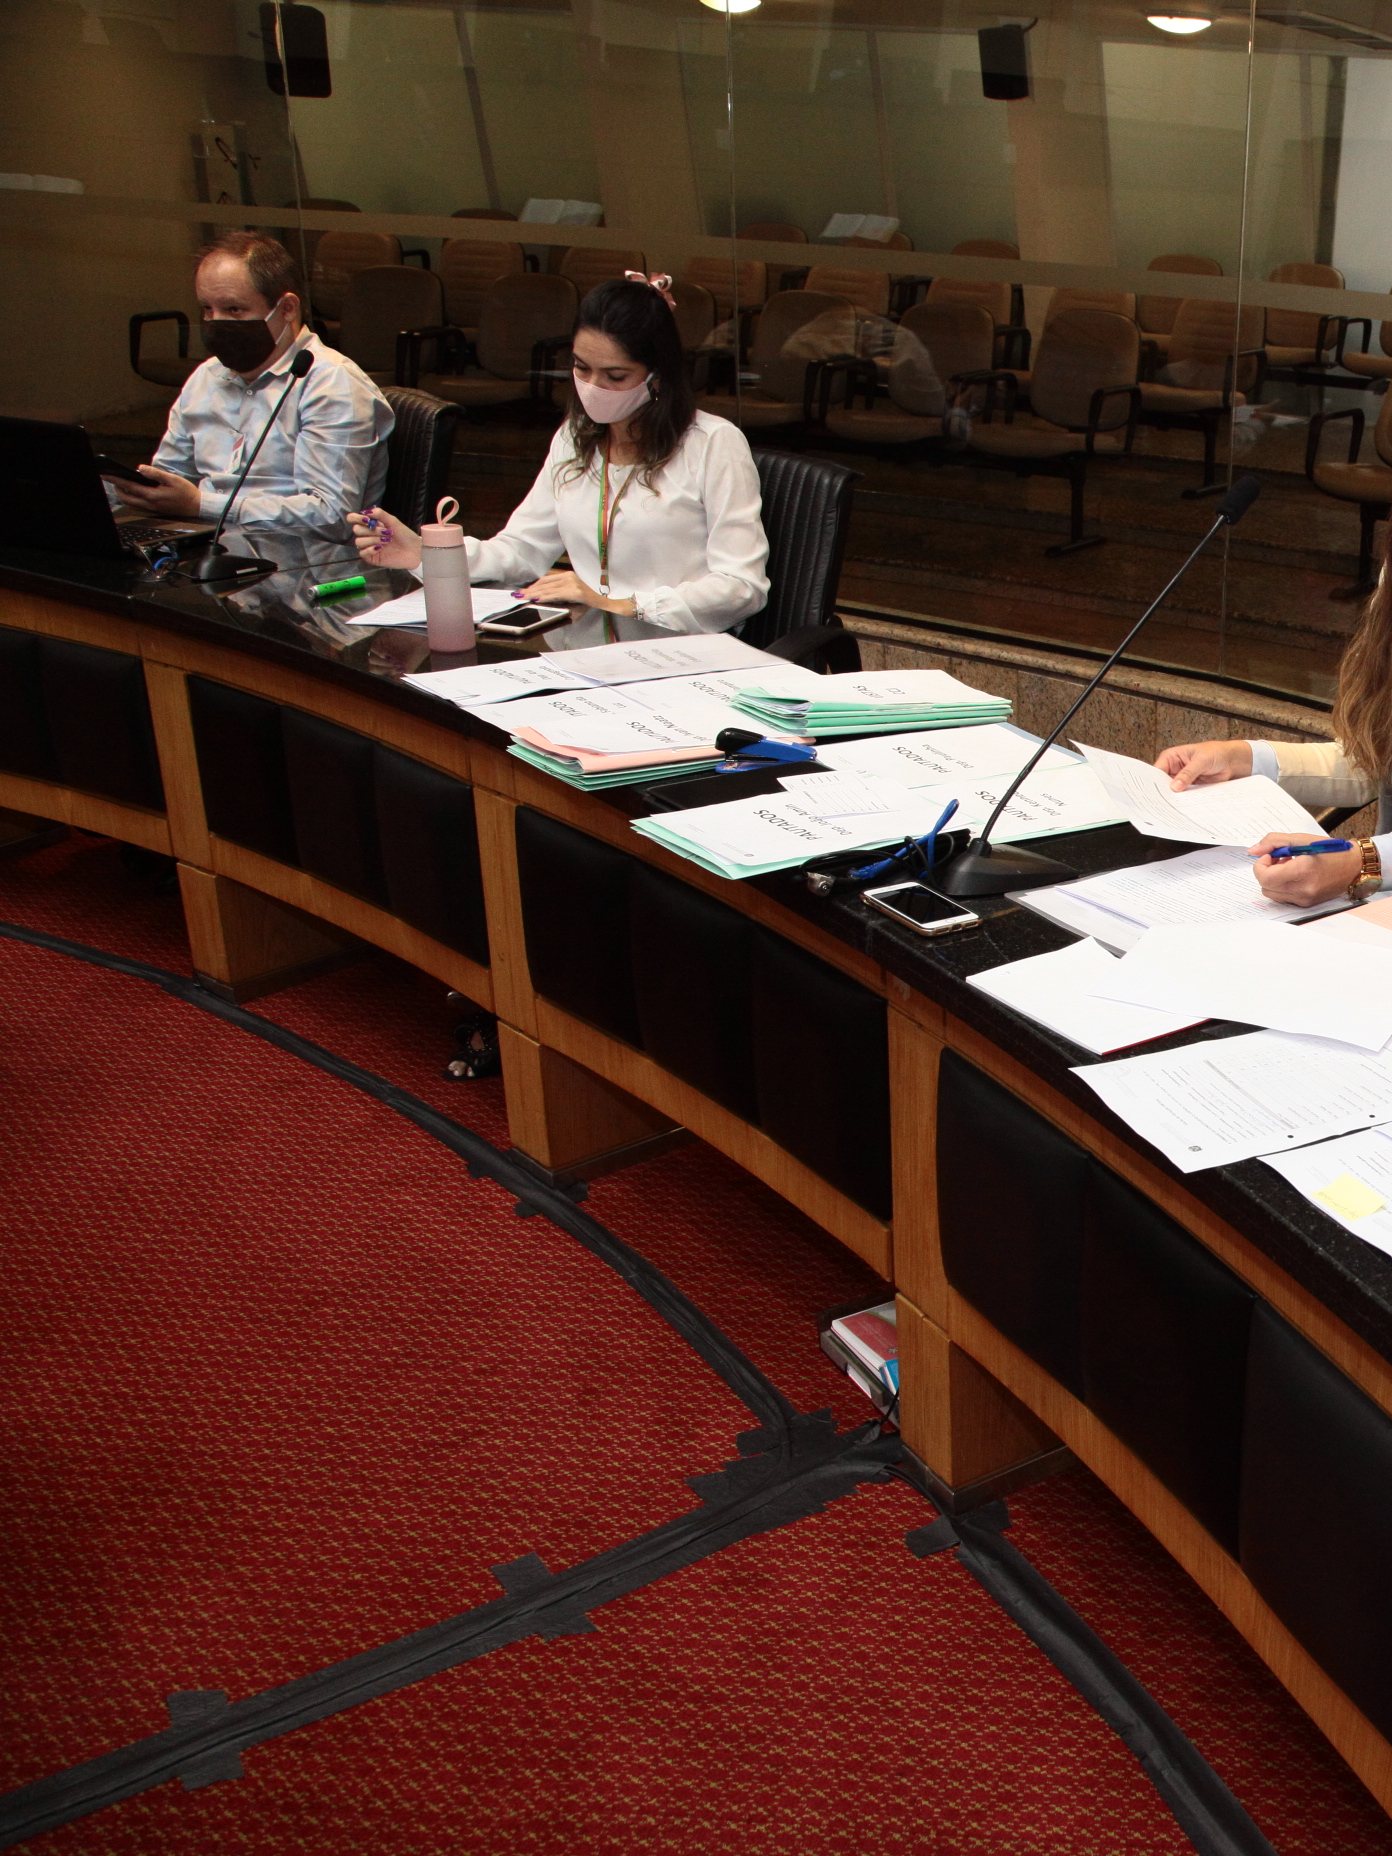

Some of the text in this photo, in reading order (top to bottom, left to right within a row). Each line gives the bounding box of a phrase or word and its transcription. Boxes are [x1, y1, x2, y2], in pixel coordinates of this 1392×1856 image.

[892, 746, 952, 774] PAUTADOS
[785, 803, 810, 816] Amin
[974, 790, 1039, 822] PAUTDOS
[752, 808, 824, 841] PAUTADOS
